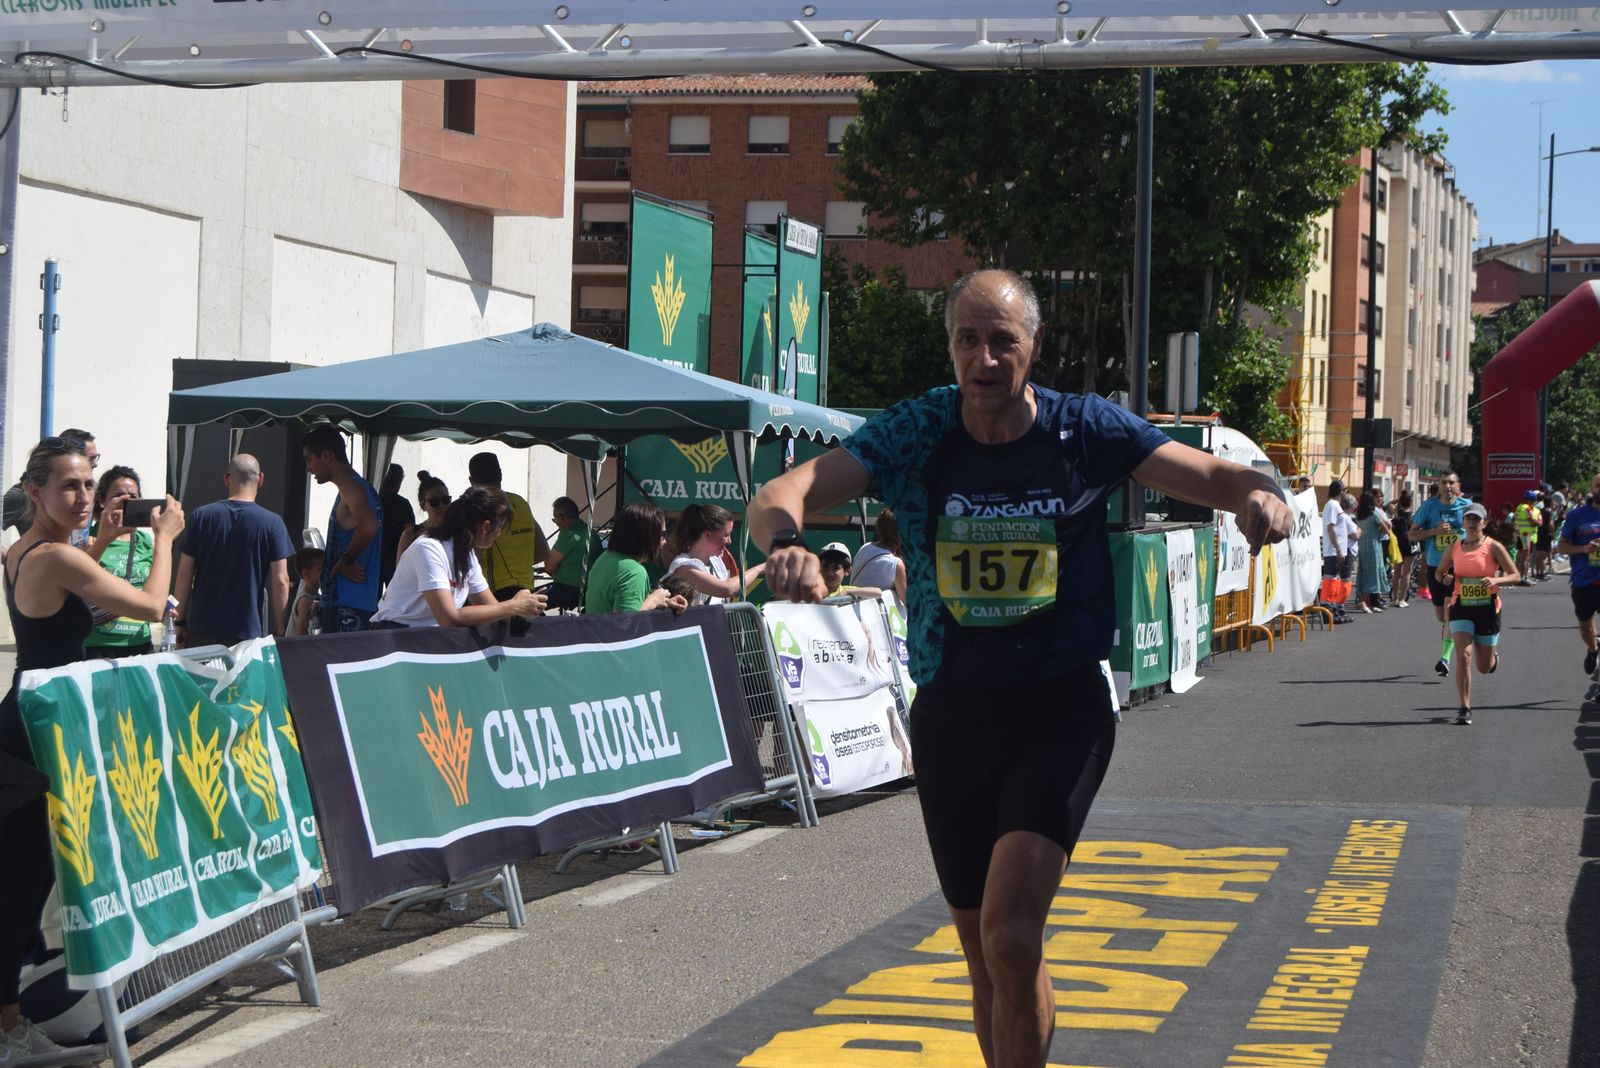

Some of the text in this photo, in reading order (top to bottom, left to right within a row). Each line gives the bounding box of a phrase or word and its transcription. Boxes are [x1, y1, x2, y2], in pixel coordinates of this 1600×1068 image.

[1497, 467, 1533, 475] ZAMORA
[639, 479, 763, 501] CAJA RURL
[972, 532, 1040, 541] CAJA RURAL
[951, 549, 1040, 592] 157
[1462, 585, 1488, 598] 0968
[970, 606, 1001, 618] CAJA
[483, 690, 682, 790] CAJA RURAL
[1328, 819, 1409, 877] INTERIORES
[1304, 879, 1391, 926] DISEÑO
[1245, 945, 1370, 1034] INTEGRAL
